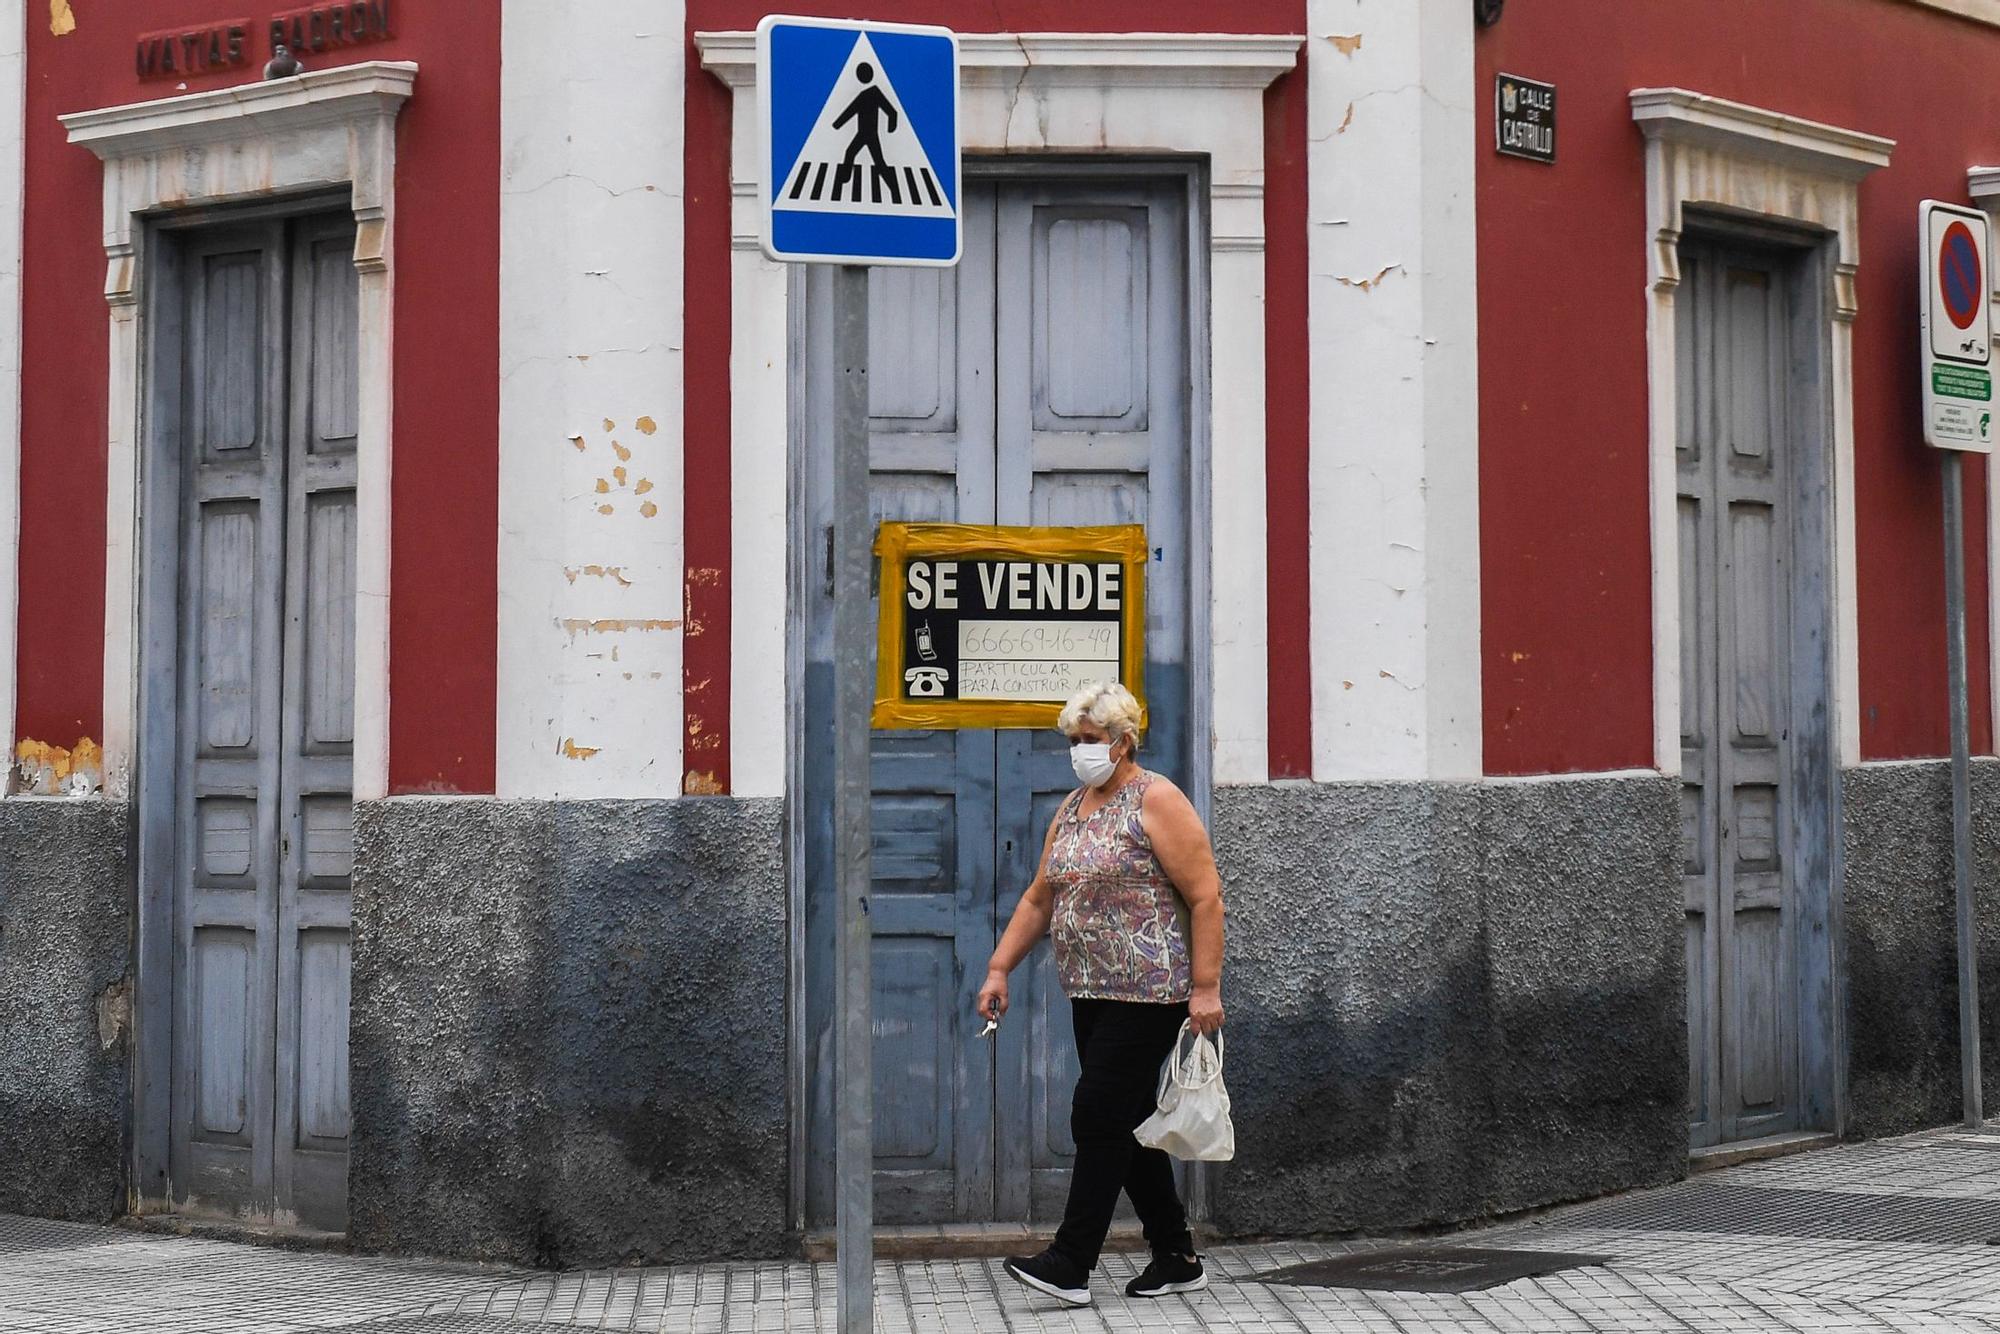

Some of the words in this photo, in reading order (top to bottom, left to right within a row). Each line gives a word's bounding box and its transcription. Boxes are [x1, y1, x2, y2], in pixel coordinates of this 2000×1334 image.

[1520, 87, 1552, 110] CALLE
[1527, 109, 1540, 122] DE
[1503, 118, 1553, 154] CASTRILLO
[907, 561, 959, 610] SE
[977, 562, 1121, 611] VENDE
[960, 662, 1072, 677] PARTICULAR
[960, 677, 999, 693] PARA
[1002, 677, 1071, 694] CONSTRUIR
